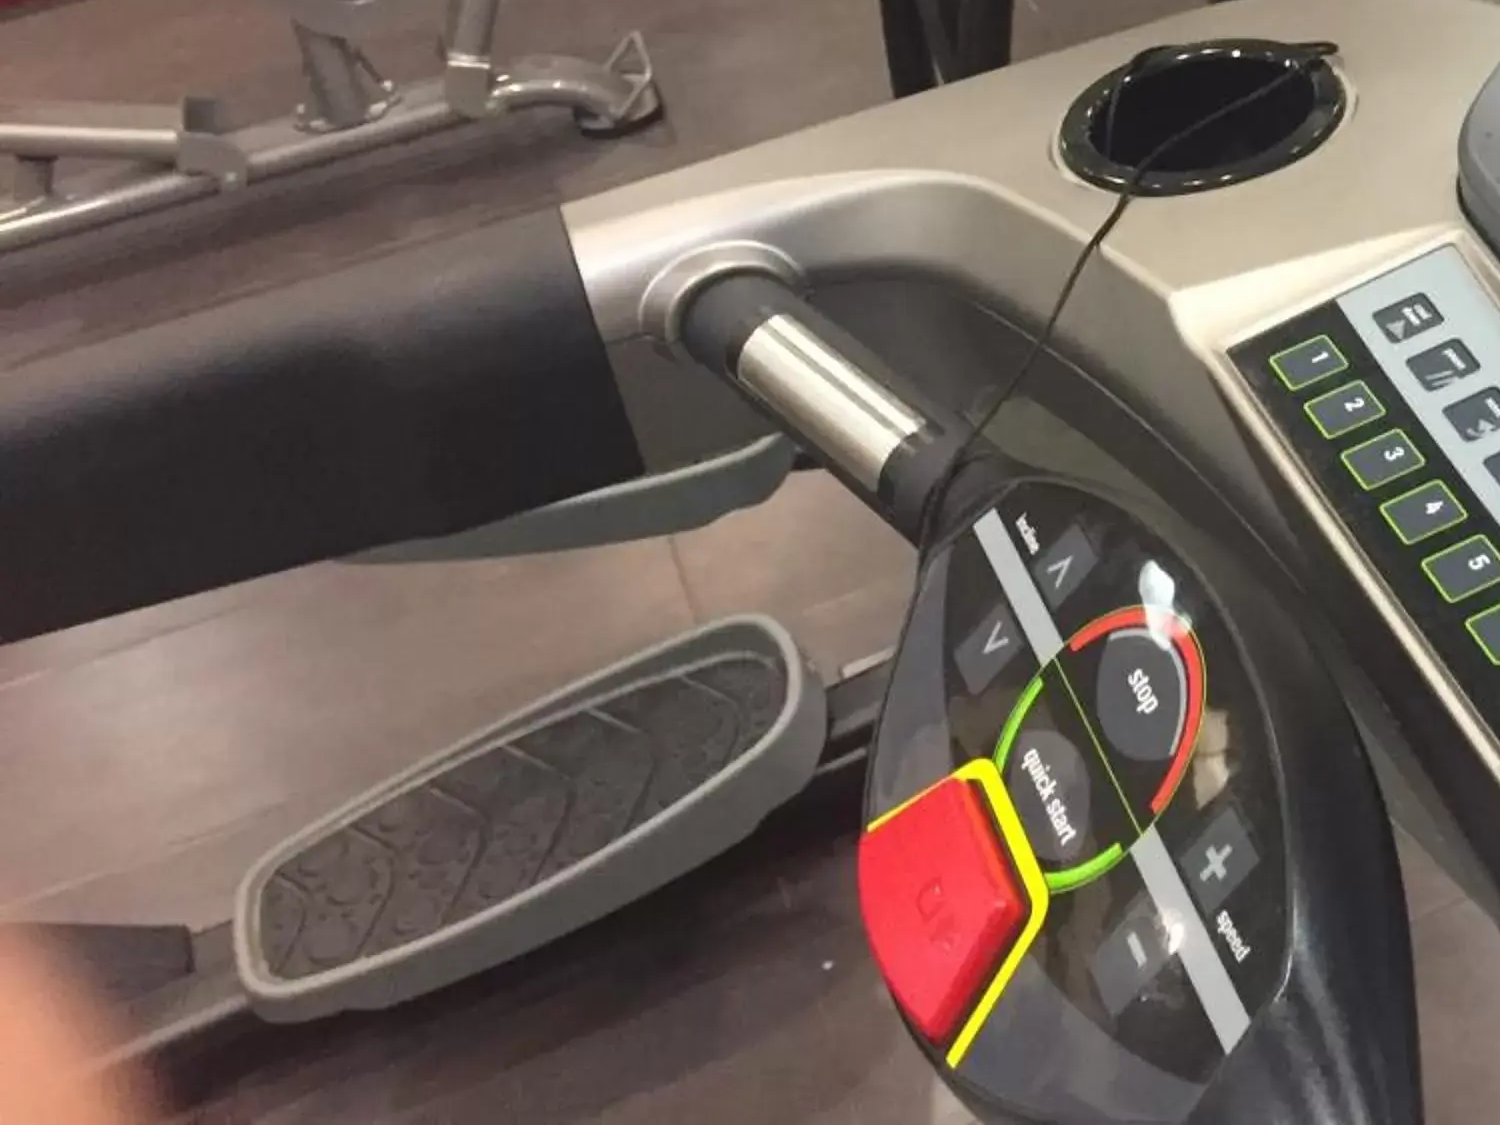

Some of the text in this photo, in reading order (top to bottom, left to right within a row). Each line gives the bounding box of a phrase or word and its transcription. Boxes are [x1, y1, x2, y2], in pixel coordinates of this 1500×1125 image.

[1311, 351, 1330, 365] 1
[1344, 397, 1365, 412] 2
[1384, 445, 1405, 462] 3
[1425, 499, 1445, 515] 4
[1467, 553, 1491, 571] 5
[1127, 668, 1159, 716] stop
[1021, 748, 1077, 846] quick start
[1216, 909, 1251, 963] speed
